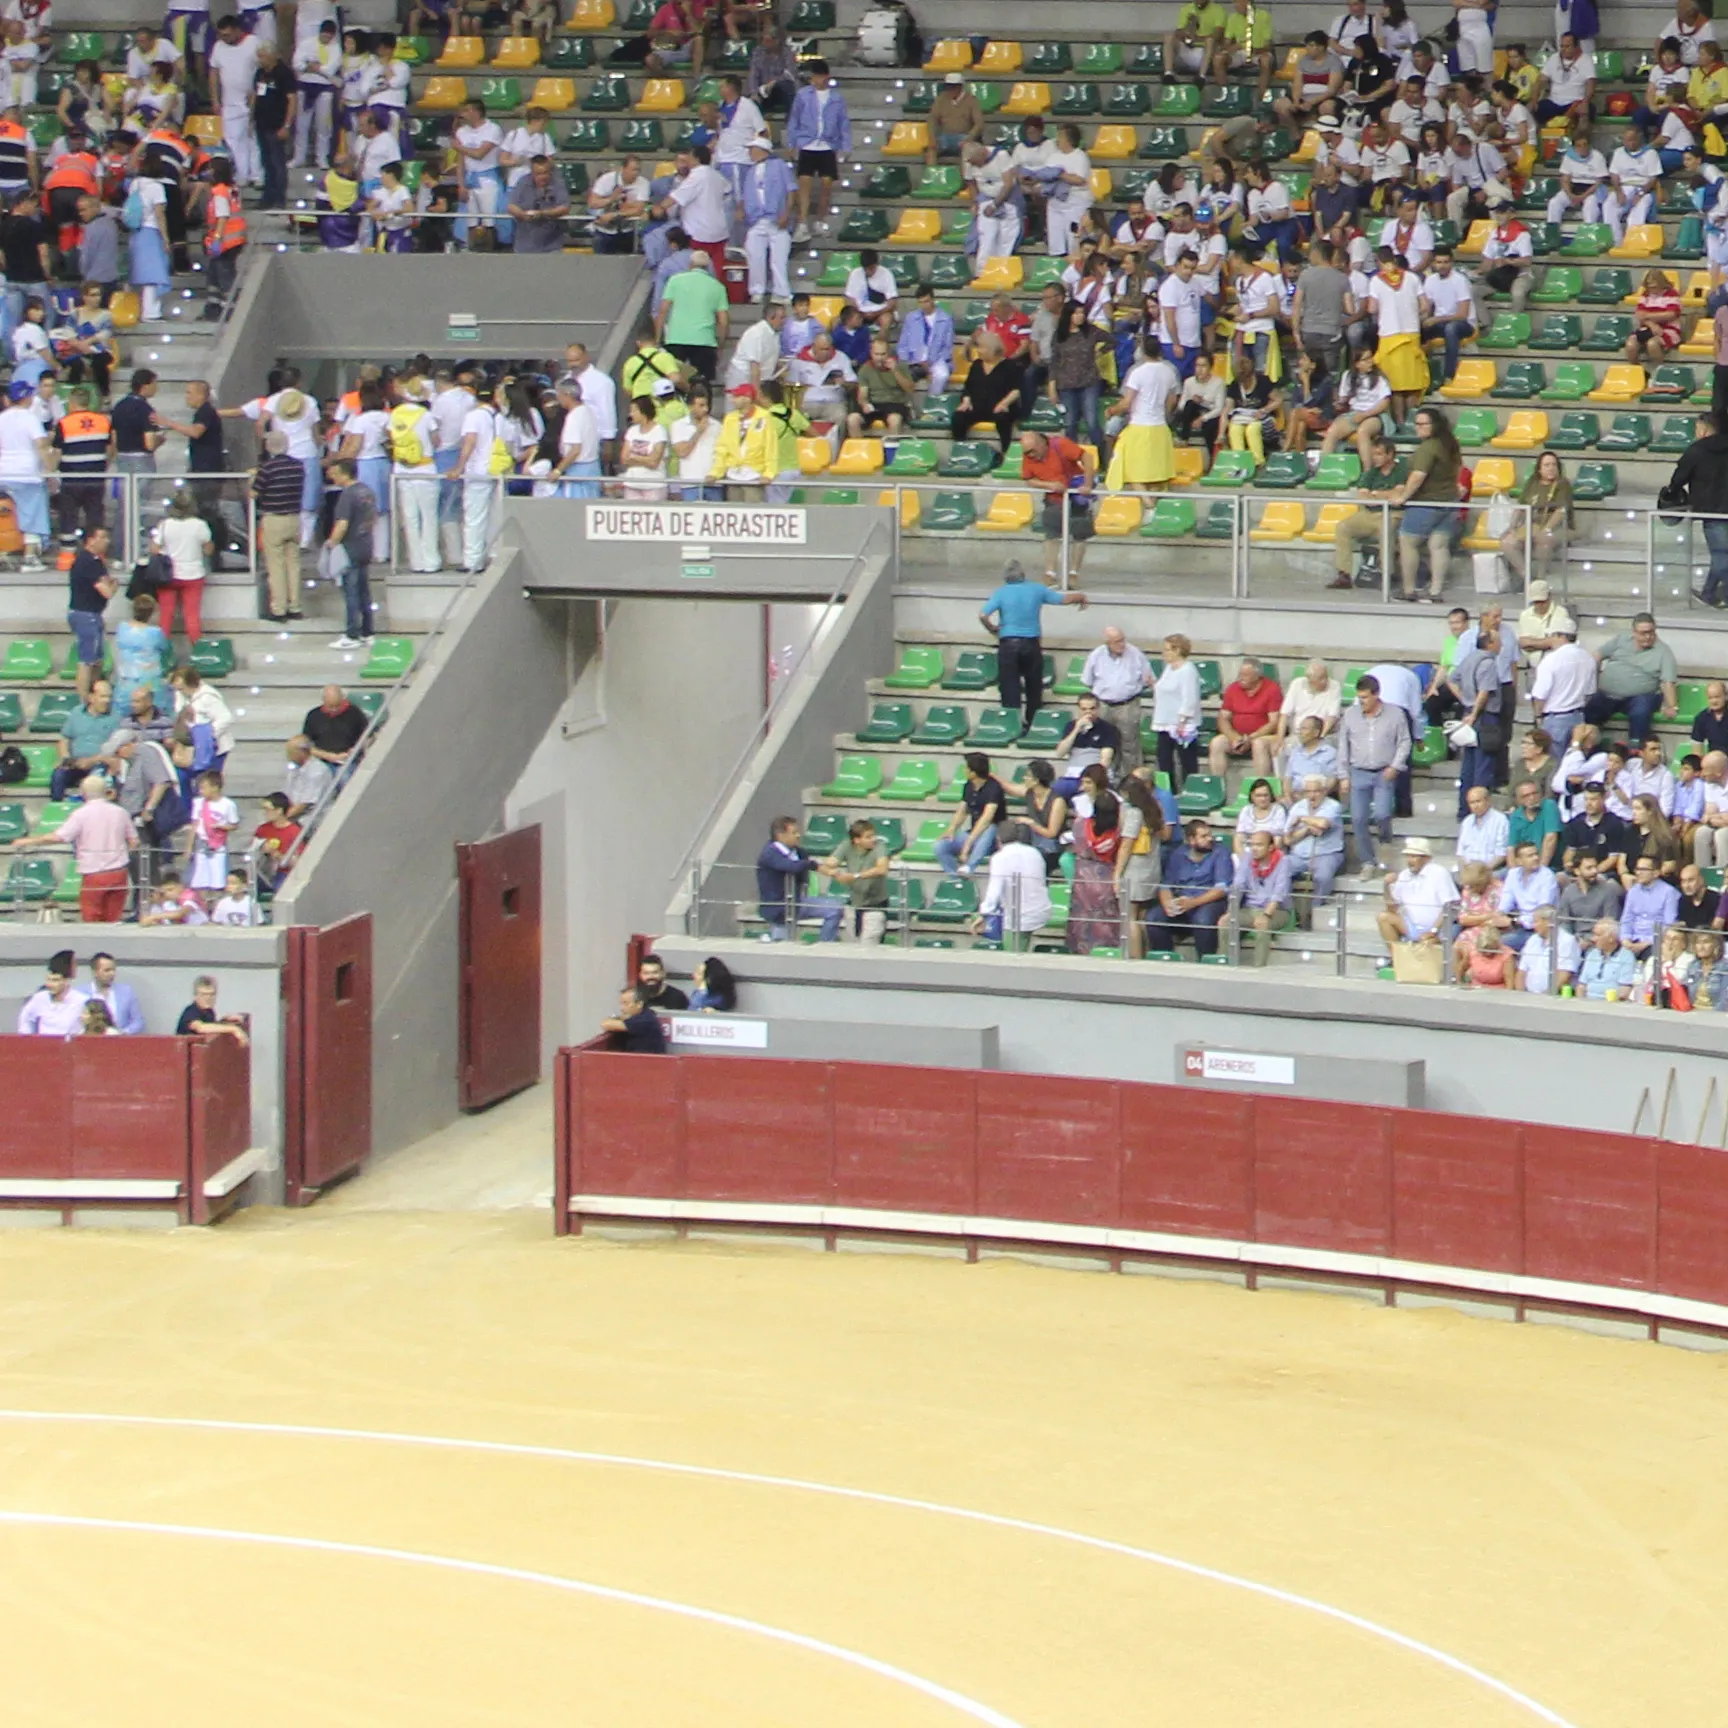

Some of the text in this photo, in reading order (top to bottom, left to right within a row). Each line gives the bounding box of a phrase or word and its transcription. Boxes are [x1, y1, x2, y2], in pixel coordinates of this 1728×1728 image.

[593, 510, 799, 539] PUERTA DE ARRASTRE
[1186, 1055, 1257, 1073] 04 ARENEROS
